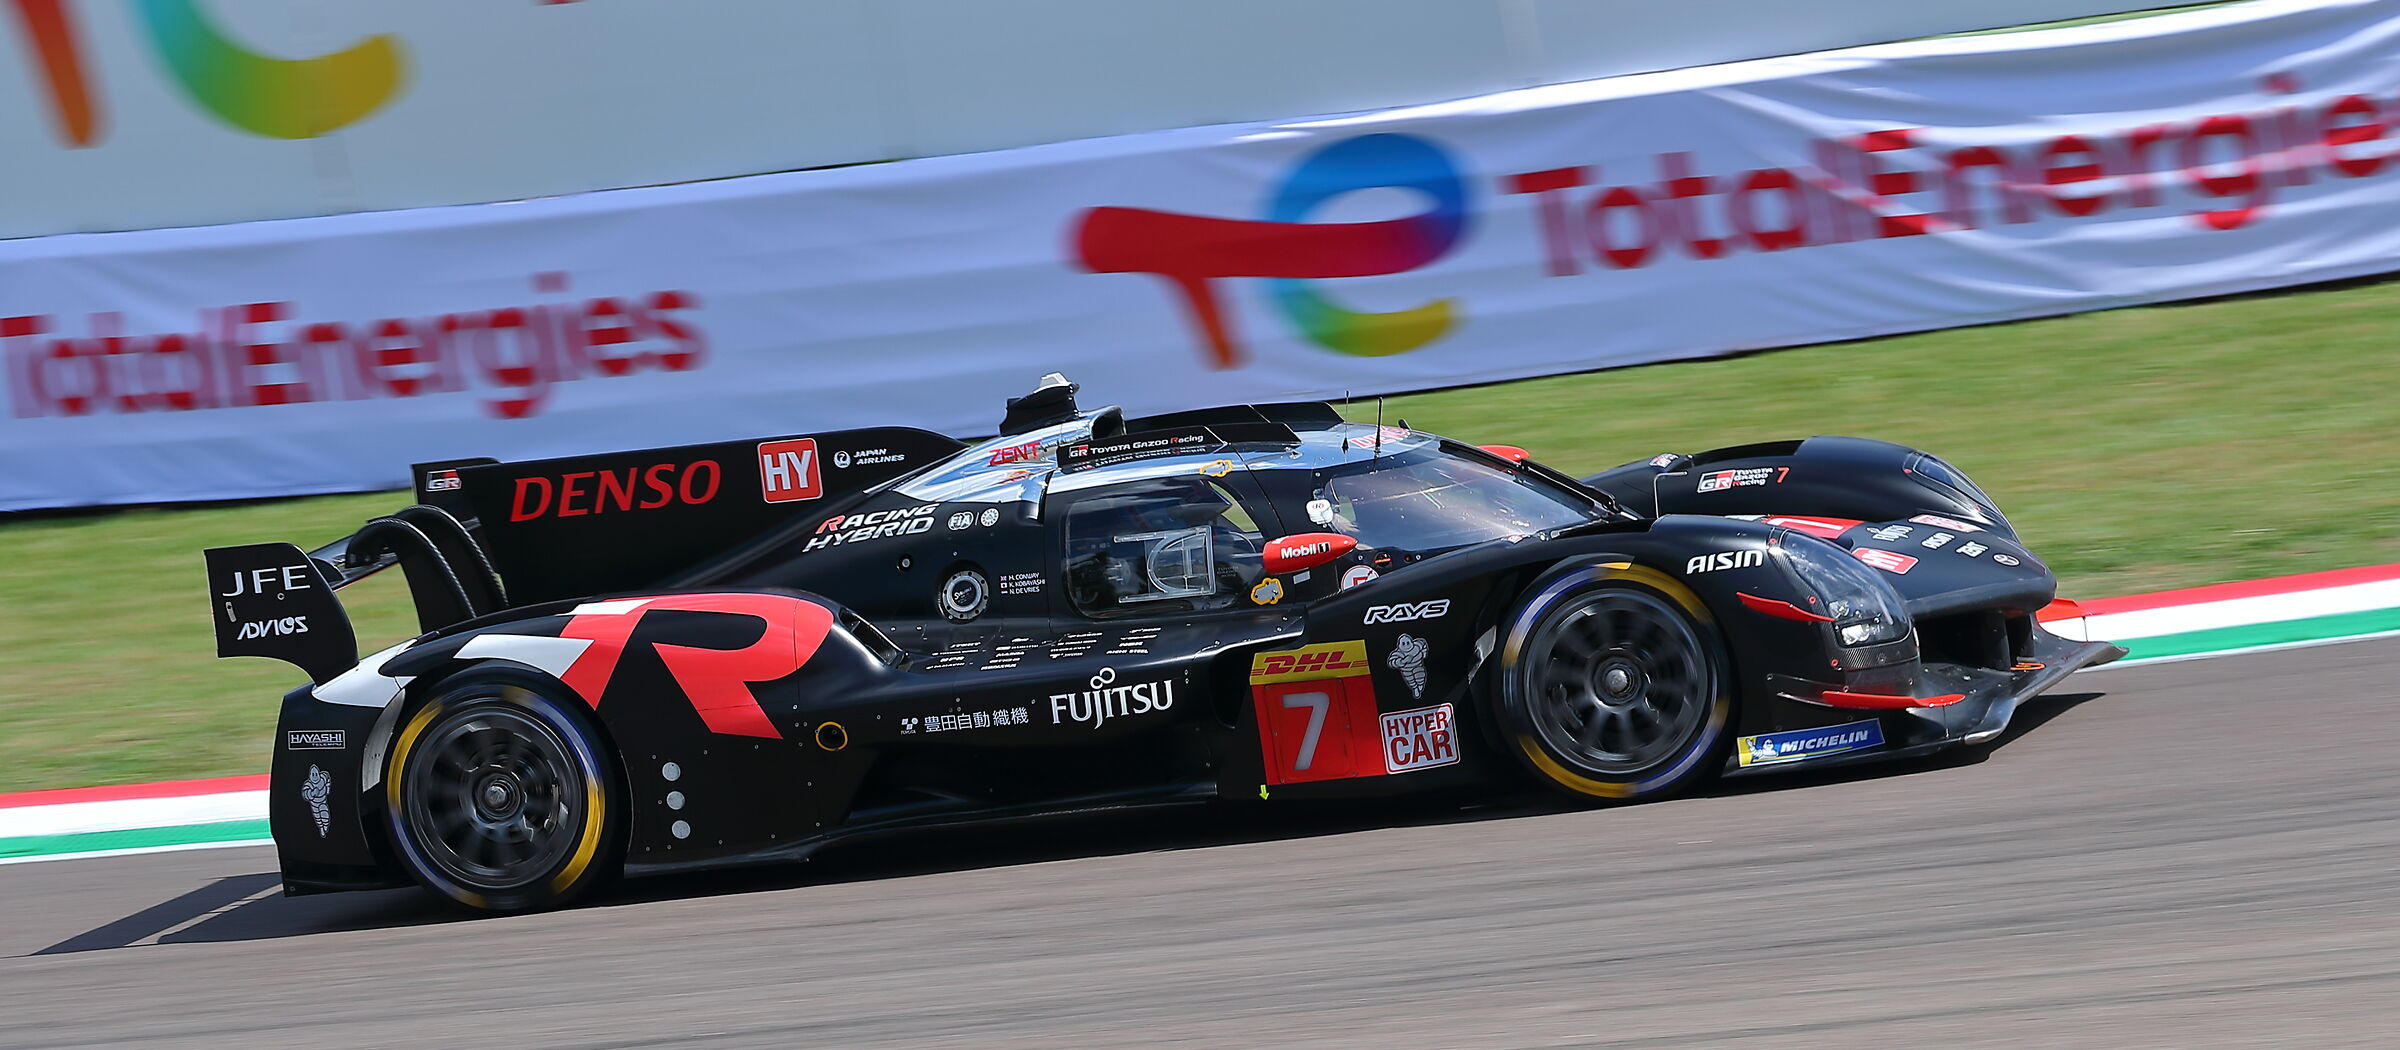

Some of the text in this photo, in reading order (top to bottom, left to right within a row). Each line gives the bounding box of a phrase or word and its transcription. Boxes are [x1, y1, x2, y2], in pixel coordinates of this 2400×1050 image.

[1498, 72, 2400, 278] TotalEnergie
[0, 270, 710, 418] TotalEnergies
[853, 448, 887, 458] JAPAN
[989, 442, 1041, 465] ZENT
[1090, 444, 1131, 454] TOYOTA
[1133, 439, 1169, 449] GAZOO
[1170, 435, 1204, 445] Racing
[763, 447, 814, 492] HY
[856, 454, 905, 465] AIRLINES
[1776, 466, 1790, 483] 7
[509, 460, 722, 523] DENSO
[815, 502, 941, 535] RACING
[949, 513, 972, 529] FIA
[802, 516, 936, 553] HYBRID
[1281, 543, 1317, 559] Mobil
[1686, 549, 1763, 574] AISIN
[222, 564, 311, 597] JFE
[1363, 599, 1450, 624] RAYS
[237, 616, 309, 640] ADVICS
[1262, 651, 1354, 675] DHL
[1049, 678, 1173, 730] FUJITSU
[1282, 691, 1331, 771] 7
[1387, 711, 1450, 737] HYPER
[291, 733, 343, 744] HAYASHI
[1390, 730, 1454, 766] CAR
[1780, 730, 1869, 753] MICHELIN
